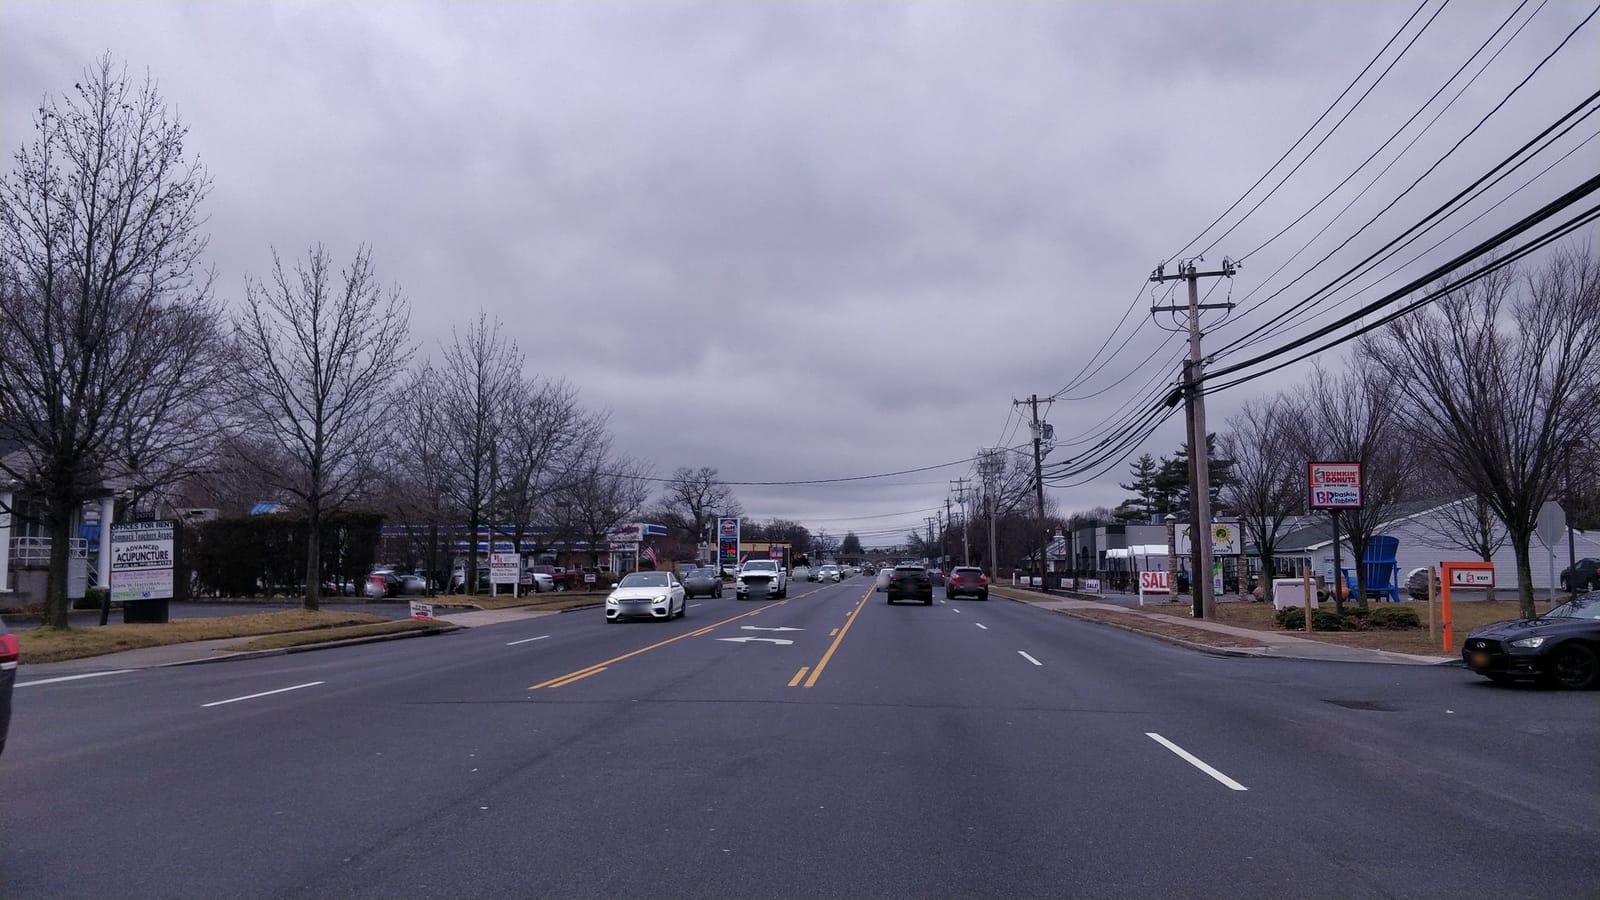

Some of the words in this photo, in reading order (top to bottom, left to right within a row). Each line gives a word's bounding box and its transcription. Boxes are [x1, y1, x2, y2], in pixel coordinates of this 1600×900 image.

[1316, 491, 1335, 504] BR
[110, 522, 139, 531] OFFICES
[140, 520, 155, 529] FOR
[156, 520, 173, 528] RENT
[125, 544, 159, 552] ADVANCED
[116, 550, 169, 562] ACUPUNCTURE
